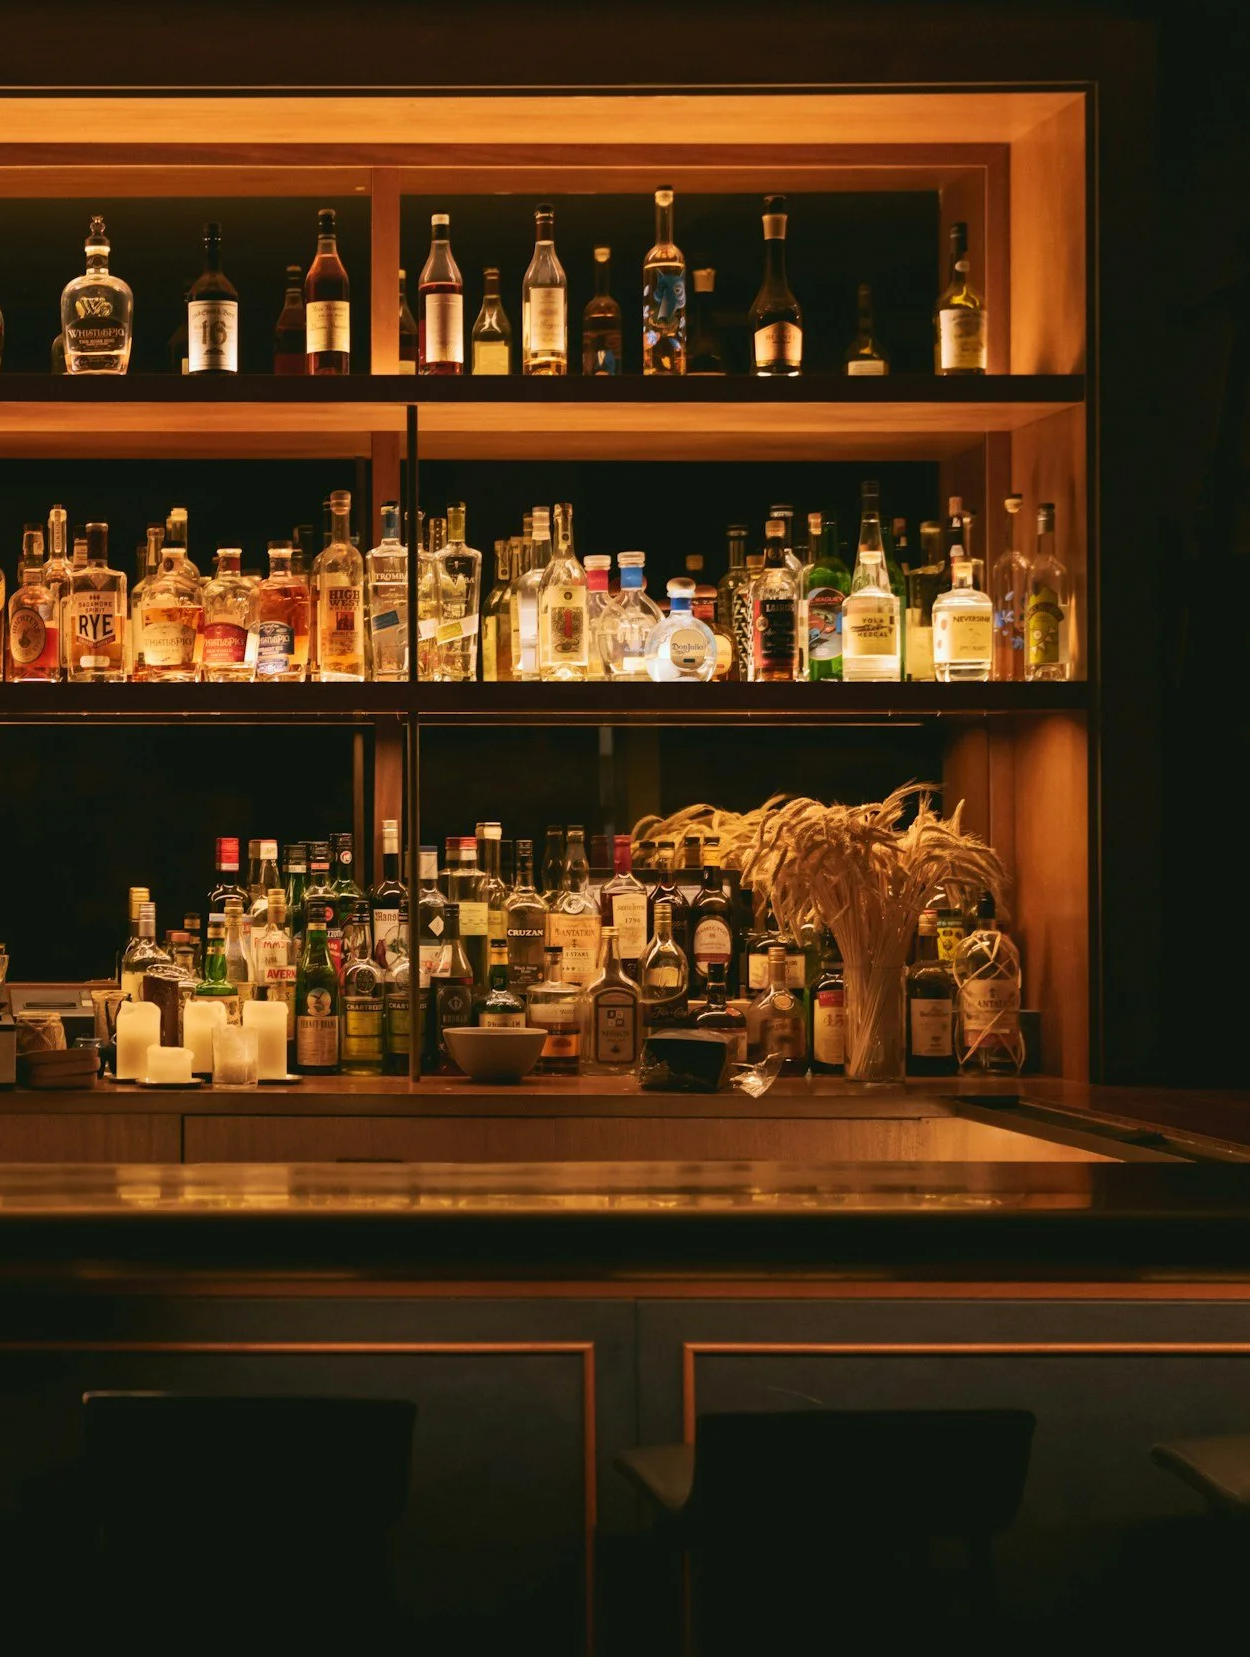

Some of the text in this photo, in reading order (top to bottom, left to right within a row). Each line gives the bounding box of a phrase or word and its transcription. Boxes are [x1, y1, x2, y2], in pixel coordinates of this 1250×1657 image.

[201, 320, 228, 346] 16
[329, 590, 359, 600] HIGH
[953, 615, 990, 623] NEVERSINK
[79, 614, 114, 640] RYE
[507, 929, 544, 937] CRUZAN
